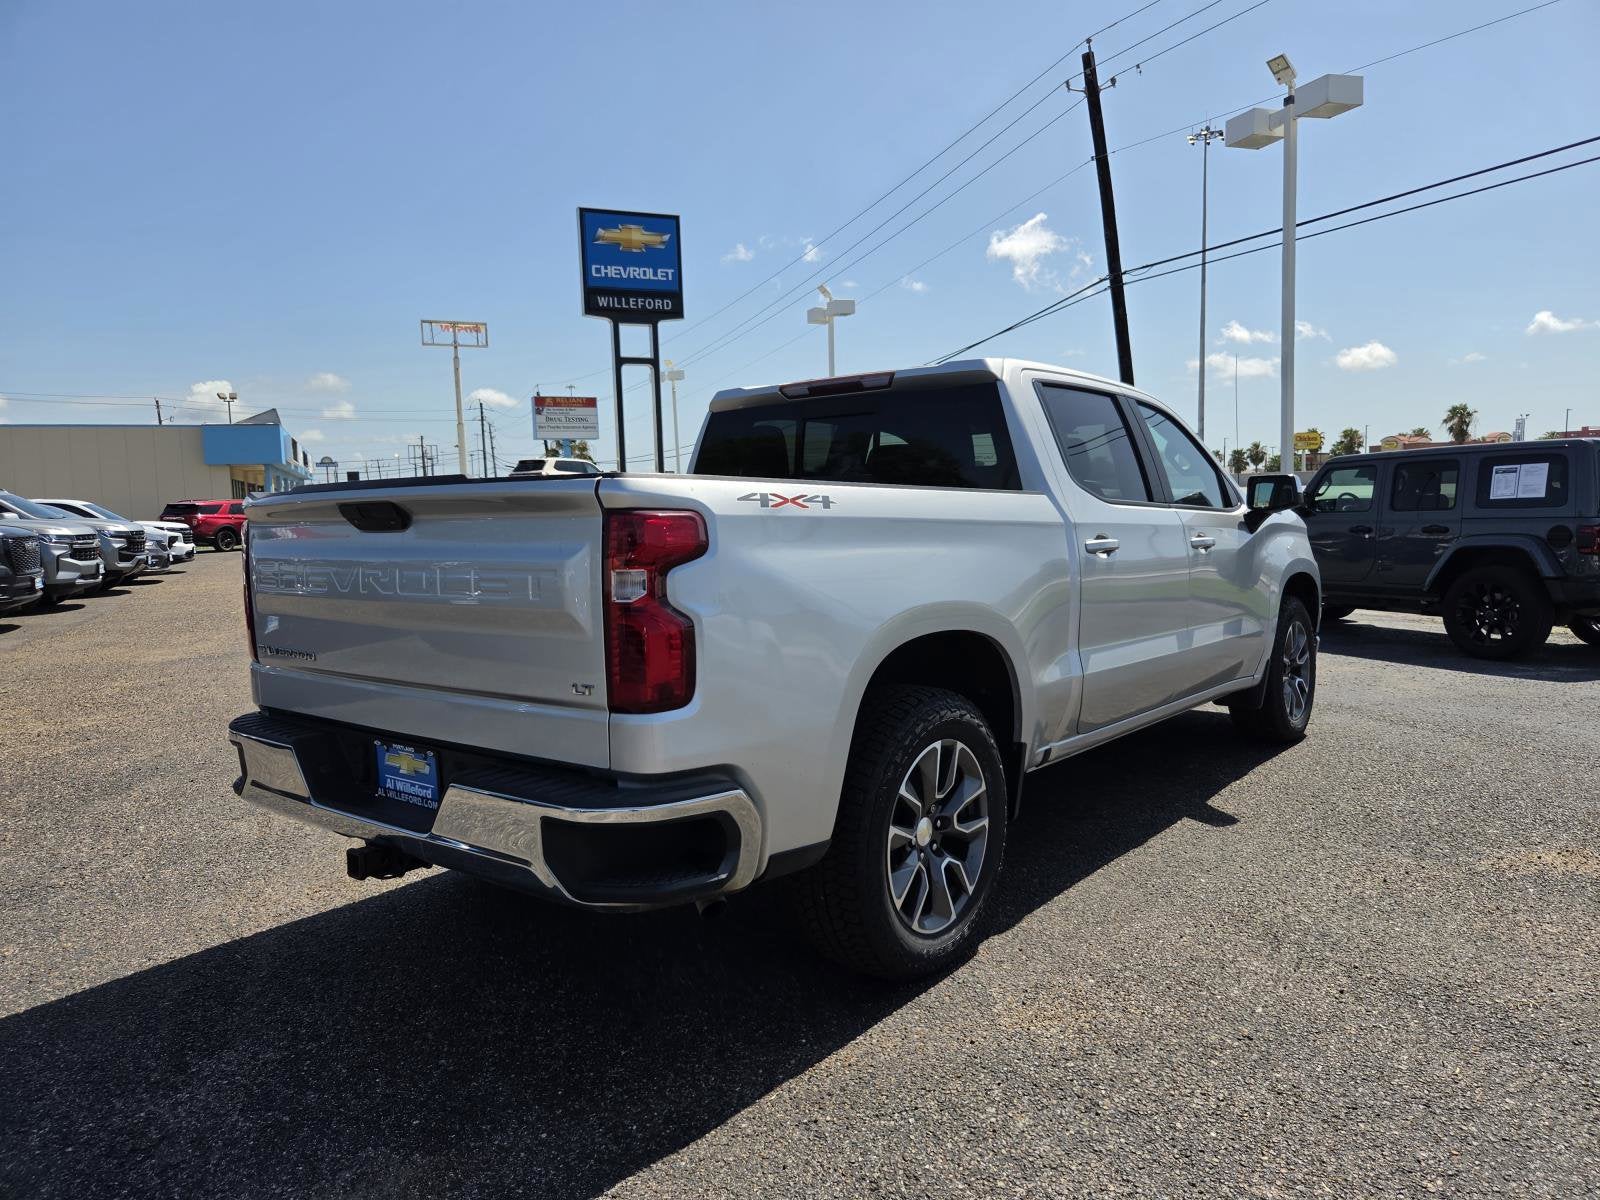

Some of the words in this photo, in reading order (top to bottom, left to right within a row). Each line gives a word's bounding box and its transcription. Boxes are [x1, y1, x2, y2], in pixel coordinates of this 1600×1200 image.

[591, 264, 675, 281] CHEVROLET
[597, 295, 672, 310] WILLEFORD
[255, 558, 558, 602] CHEVROLET
[571, 682, 595, 697] LT
[395, 780, 432, 799] Willeford
